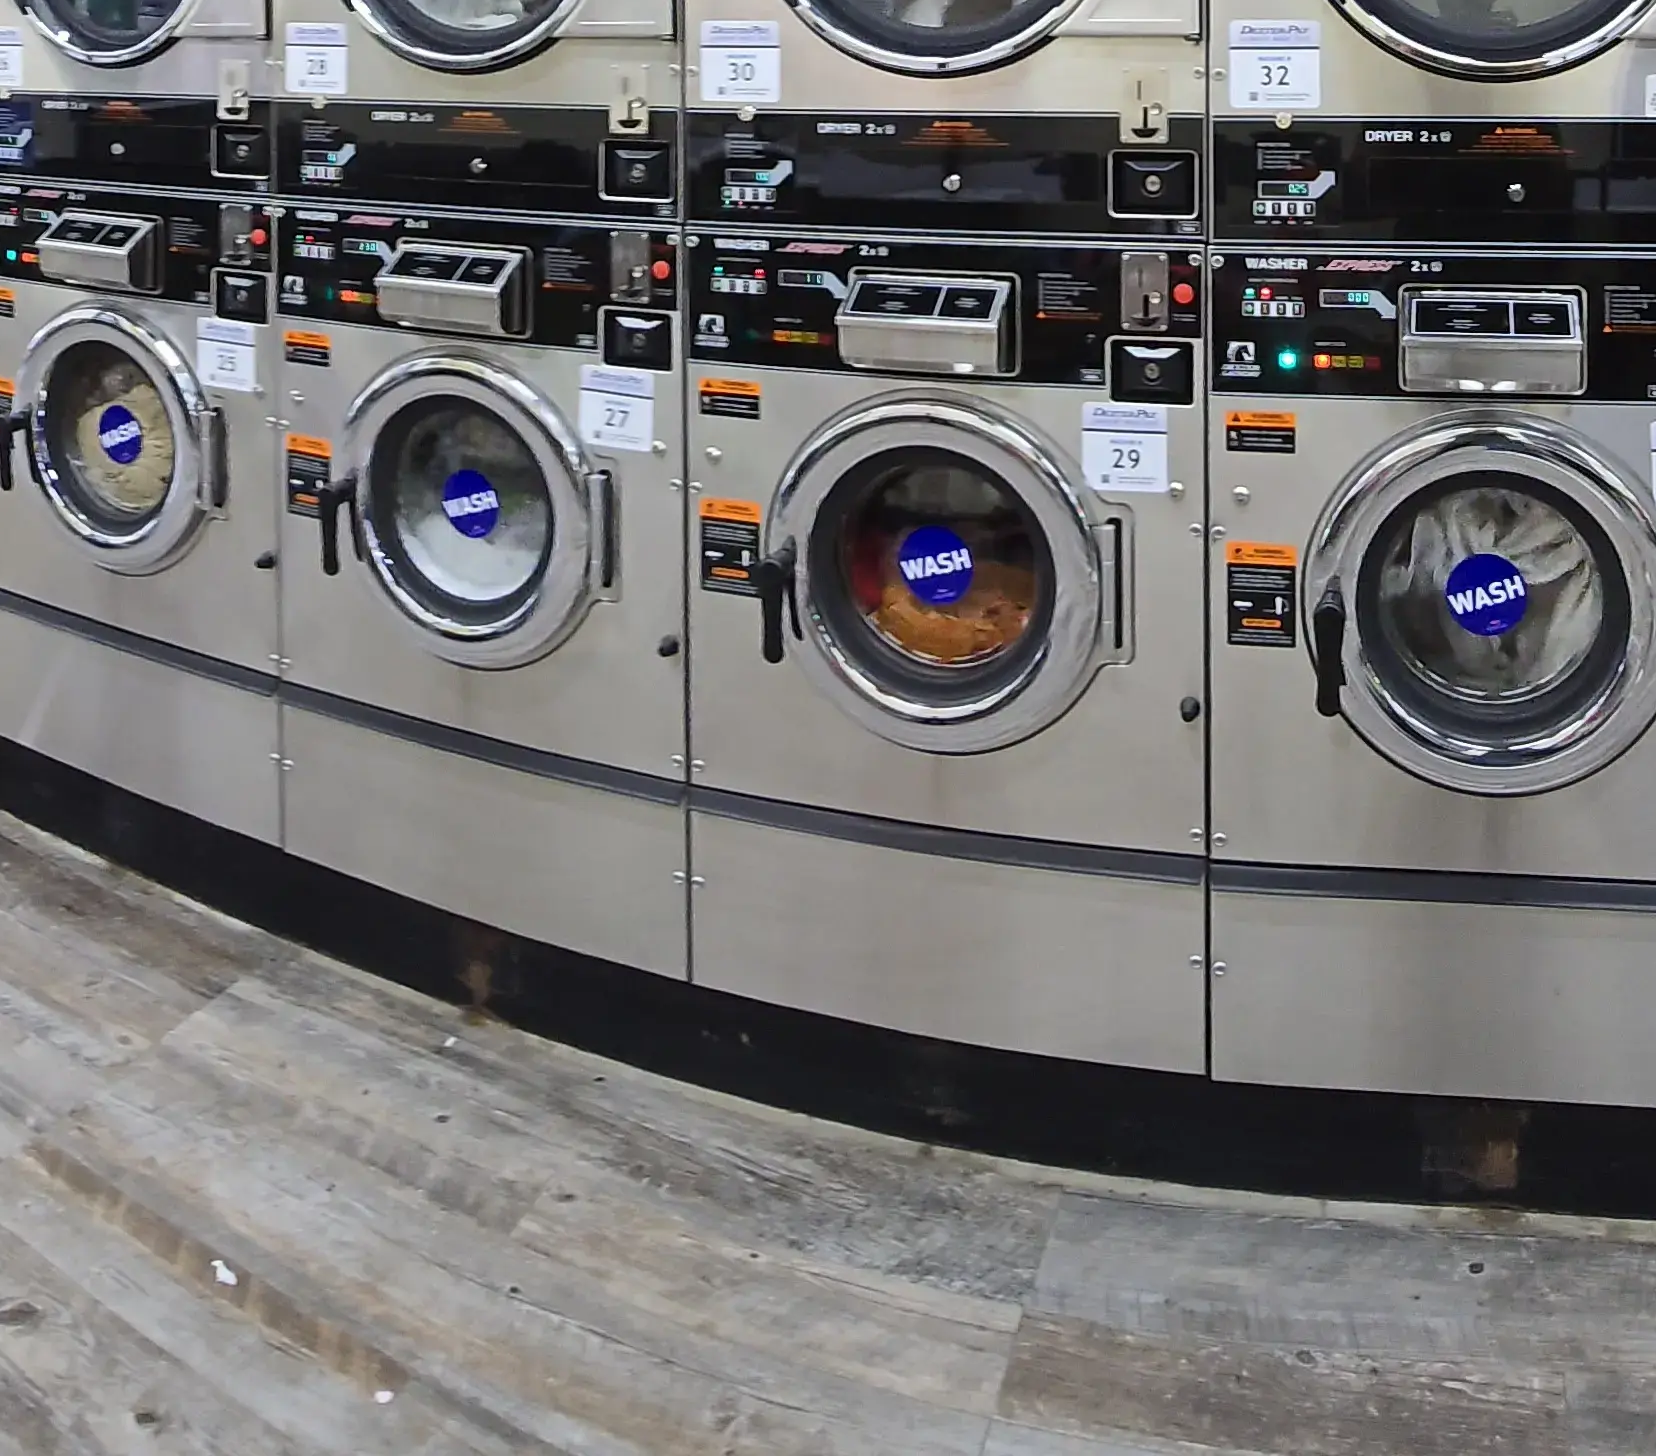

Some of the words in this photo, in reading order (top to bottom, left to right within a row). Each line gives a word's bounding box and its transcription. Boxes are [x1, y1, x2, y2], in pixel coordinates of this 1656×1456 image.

[728, 62, 755, 82] 30
[1260, 65, 1291, 87] 32
[1365, 130, 1414, 142] DRYER
[1245, 257, 1308, 271] WASHER
[604, 408, 630, 428] 27
[1112, 448, 1140, 469] 29
[900, 548, 972, 579] WASH
[1448, 576, 1525, 614] WASH
